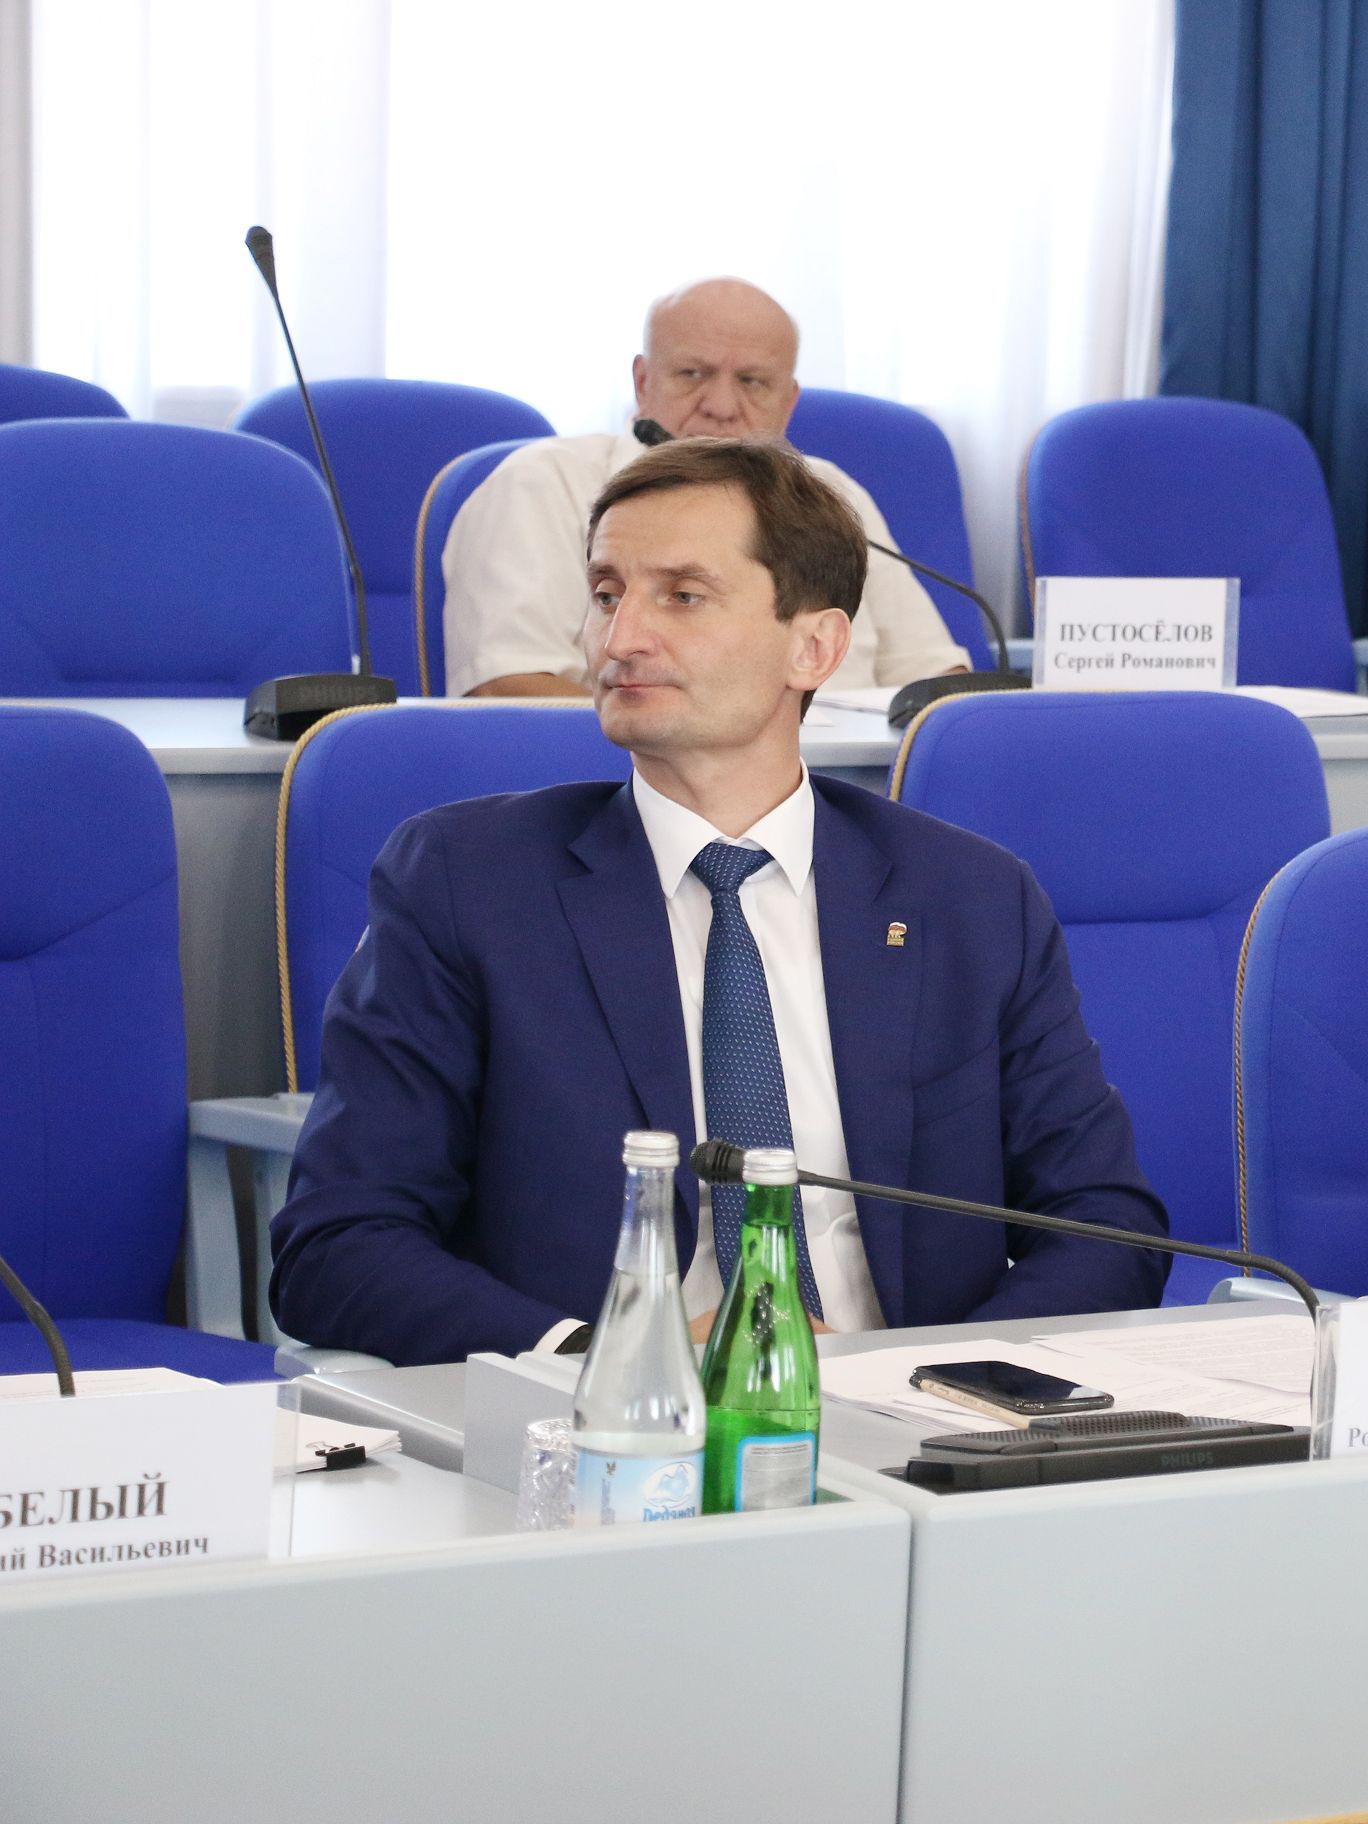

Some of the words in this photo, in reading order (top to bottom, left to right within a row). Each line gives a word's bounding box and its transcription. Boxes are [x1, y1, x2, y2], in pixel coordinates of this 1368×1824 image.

[1059, 620, 1213, 643] ПУСТОСЁЛОВ
[1054, 652, 1114, 673] Сергей
[1121, 652, 1216, 669] Романович
[38, 1537, 209, 1568] Васильевич
